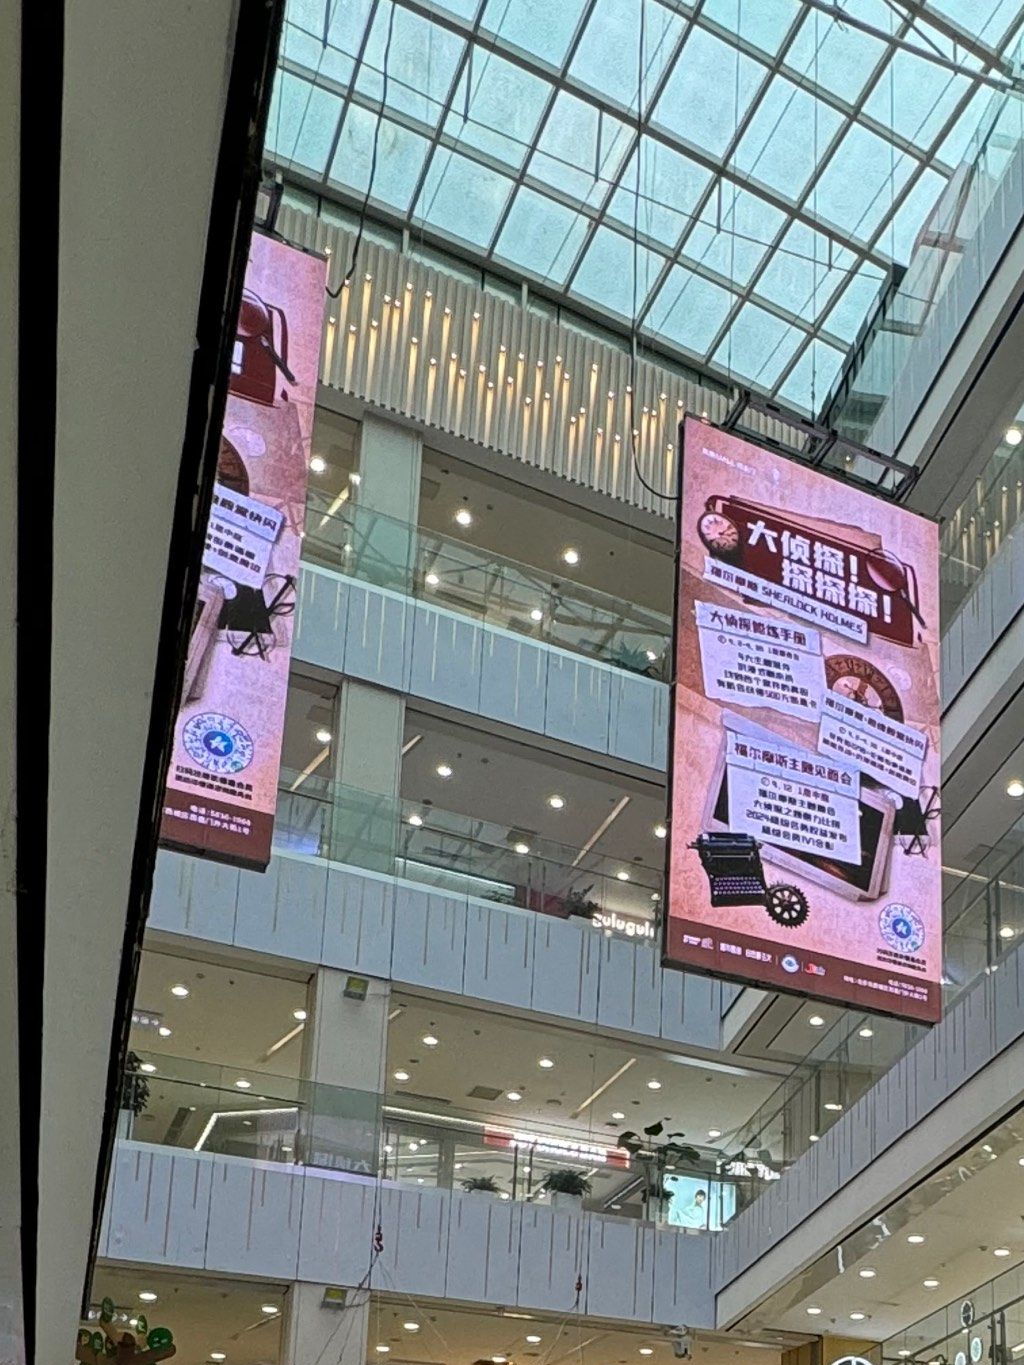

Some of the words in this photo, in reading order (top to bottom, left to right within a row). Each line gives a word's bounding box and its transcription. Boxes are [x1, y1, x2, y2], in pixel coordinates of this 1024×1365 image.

[747, 520, 858, 582] 大侦探！
[761, 586, 818, 617] SHERLOCK
[820, 608, 863, 635] HOLMES
[781, 560, 892, 623] 探探探！
[734, 742, 853, 785] 福尔摩斯主题见面会
